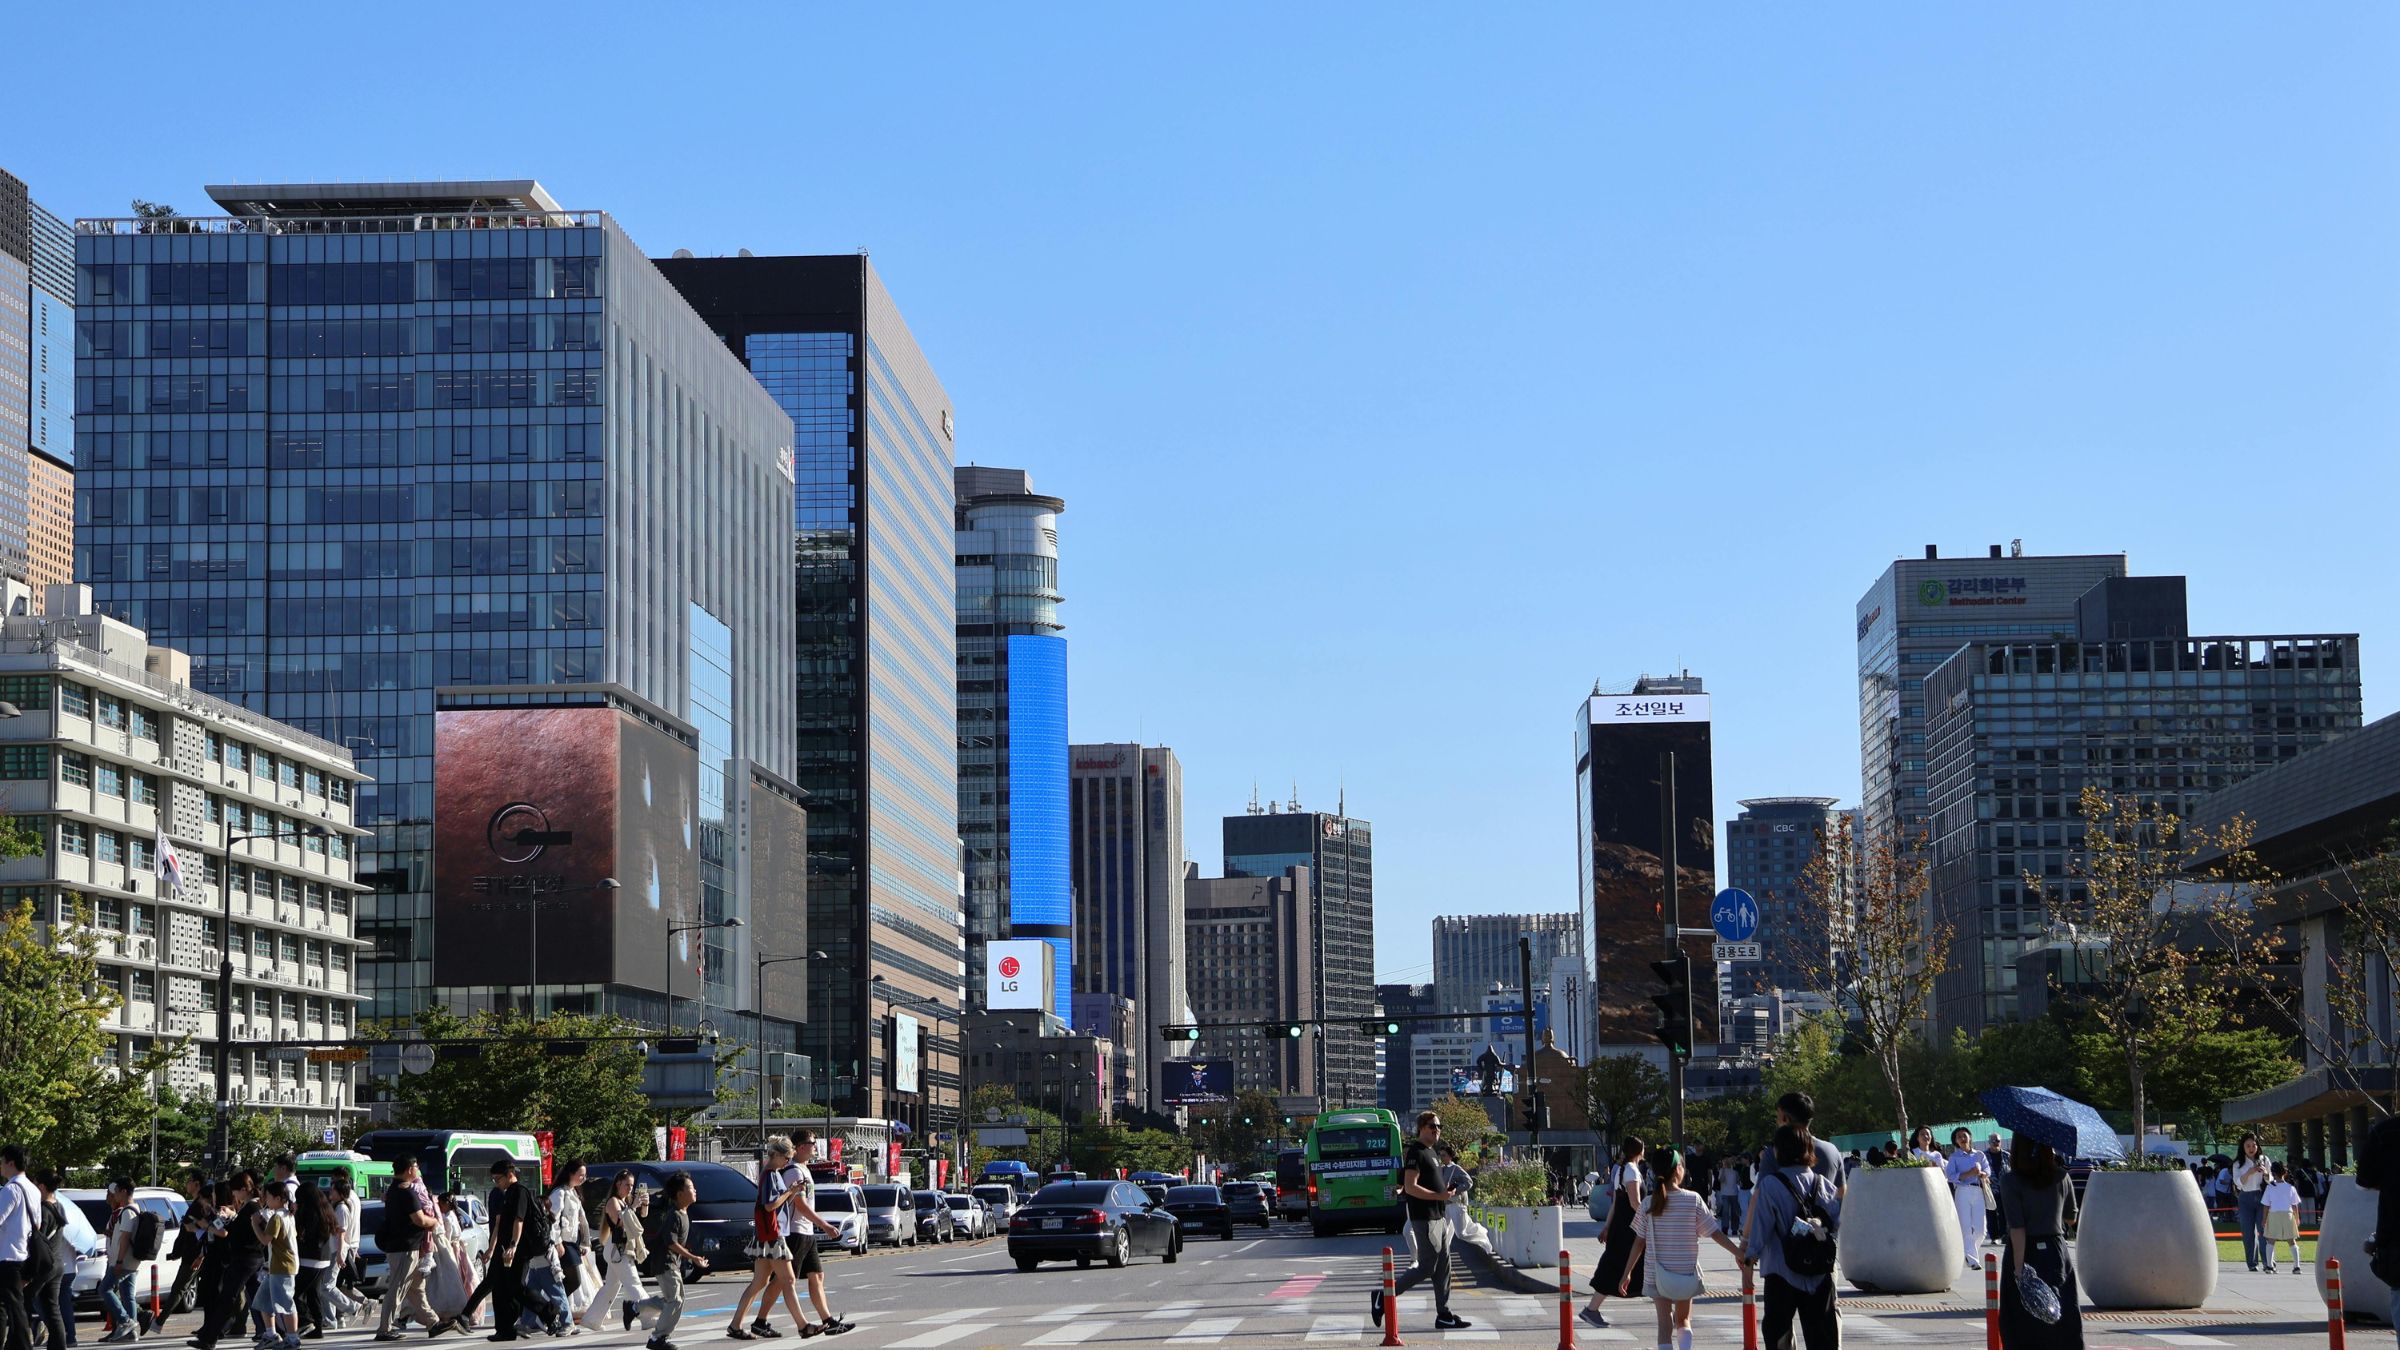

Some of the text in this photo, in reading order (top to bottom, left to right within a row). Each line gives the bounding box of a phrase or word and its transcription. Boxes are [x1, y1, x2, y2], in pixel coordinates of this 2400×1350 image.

[1947, 577, 2027, 594] 감리회본부
[1949, 595, 2027, 606] Methodist Center
[1615, 702, 1685, 716] 조선일보
[1076, 758, 1118, 770] kobaco
[1773, 824, 1795, 833] ICBC
[1716, 946, 1758, 958] 겸용도로
[1001, 981, 1018, 992] LG
[1366, 1139, 1387, 1149] 7212
[1310, 1162, 1332, 1171] 압도적
